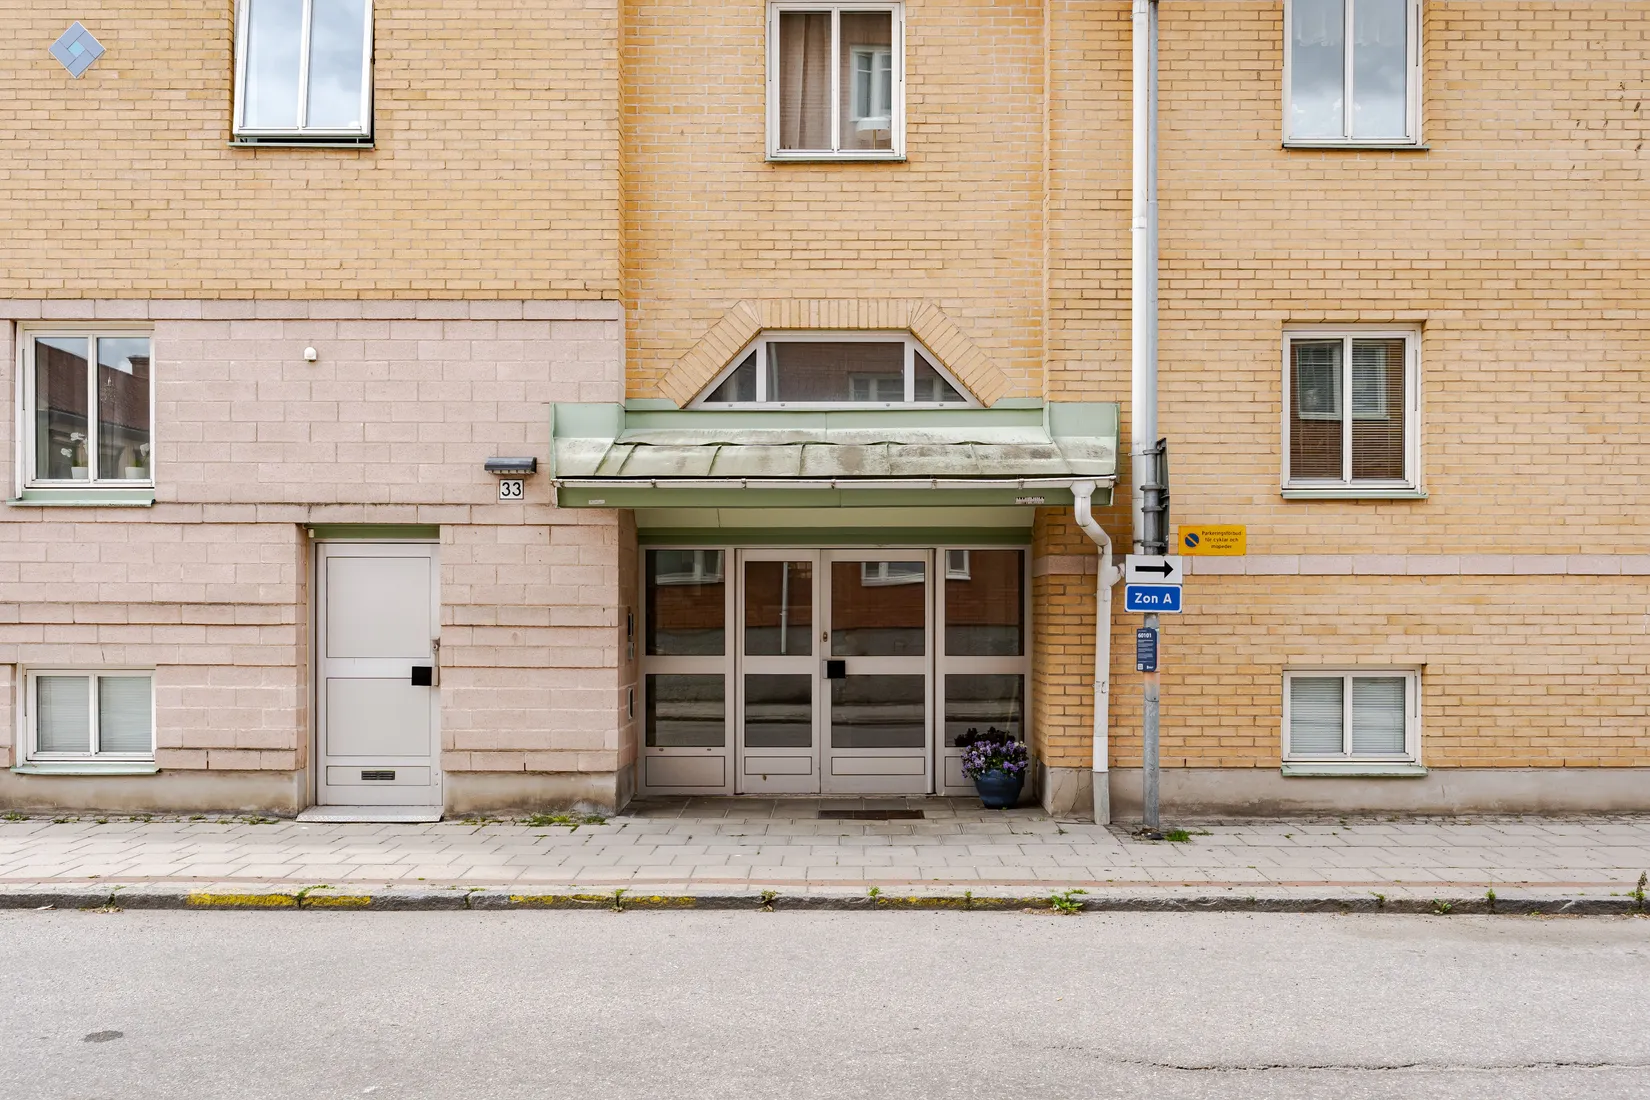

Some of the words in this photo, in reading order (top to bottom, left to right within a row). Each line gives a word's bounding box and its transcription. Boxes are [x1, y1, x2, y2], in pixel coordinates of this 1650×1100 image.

[501, 482, 521, 496] 33
[1134, 592, 1159, 604] Zon
[1162, 592, 1173, 604] A
